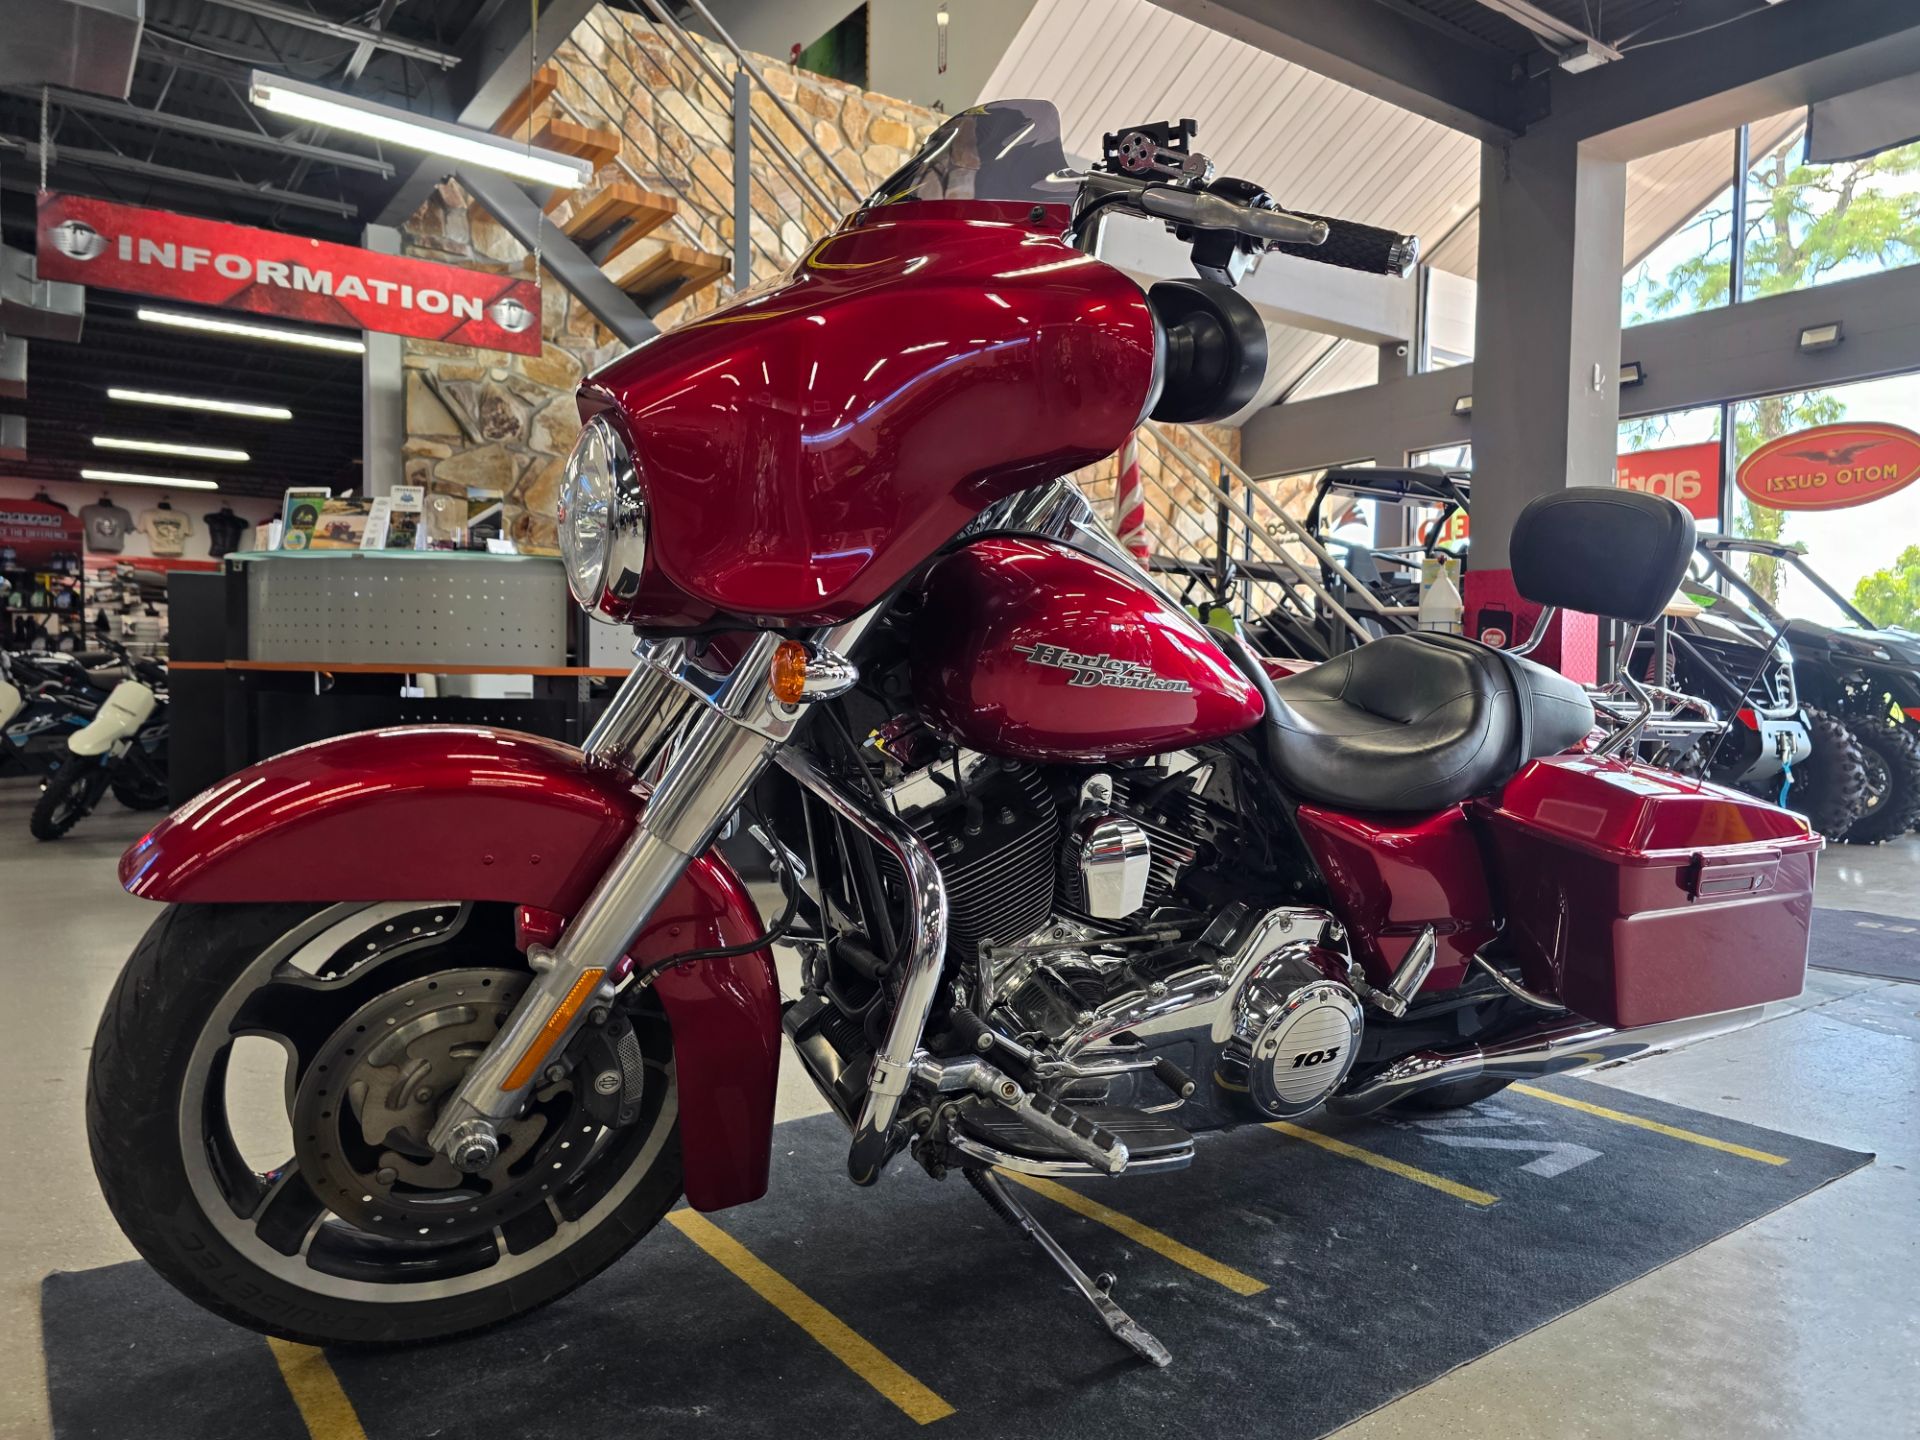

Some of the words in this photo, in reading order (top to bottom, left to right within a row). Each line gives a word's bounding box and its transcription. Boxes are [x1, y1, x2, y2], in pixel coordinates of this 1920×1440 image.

[118, 234, 484, 322] INFORMATION
[1013, 642, 1151, 676] Harley
[1067, 664, 1193, 693] Davidson
[1291, 1046, 1341, 1069] 103
